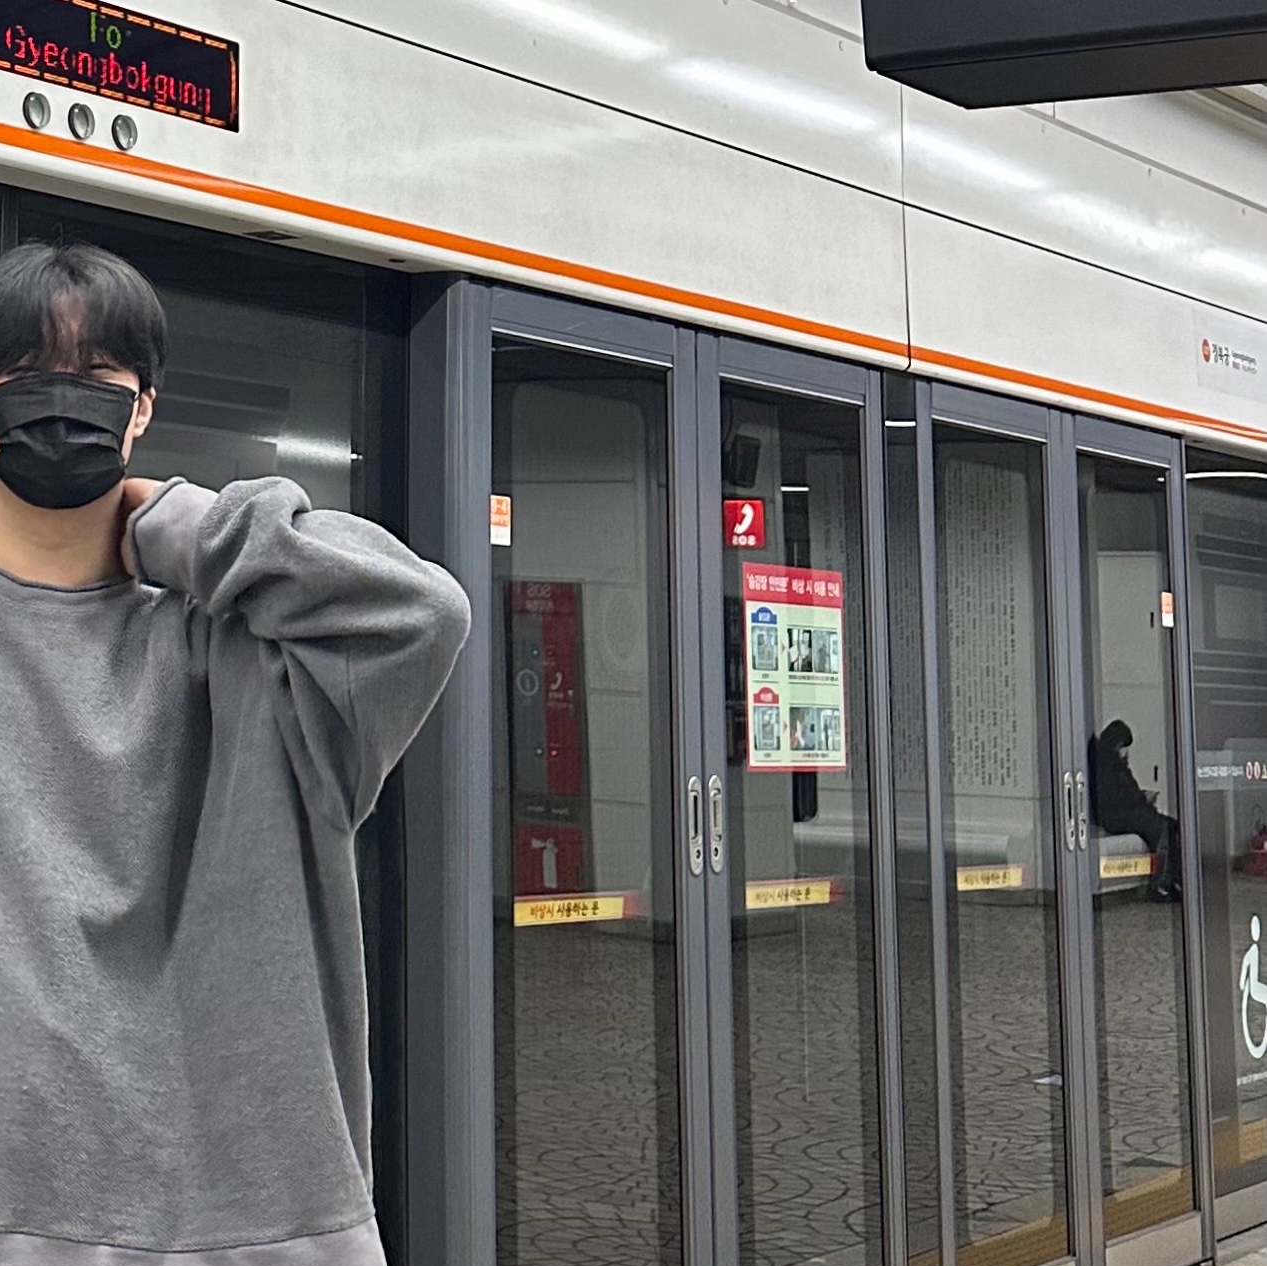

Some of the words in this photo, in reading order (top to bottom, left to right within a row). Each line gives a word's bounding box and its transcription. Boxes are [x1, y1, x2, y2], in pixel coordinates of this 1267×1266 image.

[530, 903, 555, 920] 비상시
[556, 901, 589, 918] 사용하는
[591, 900, 600, 915] 문
